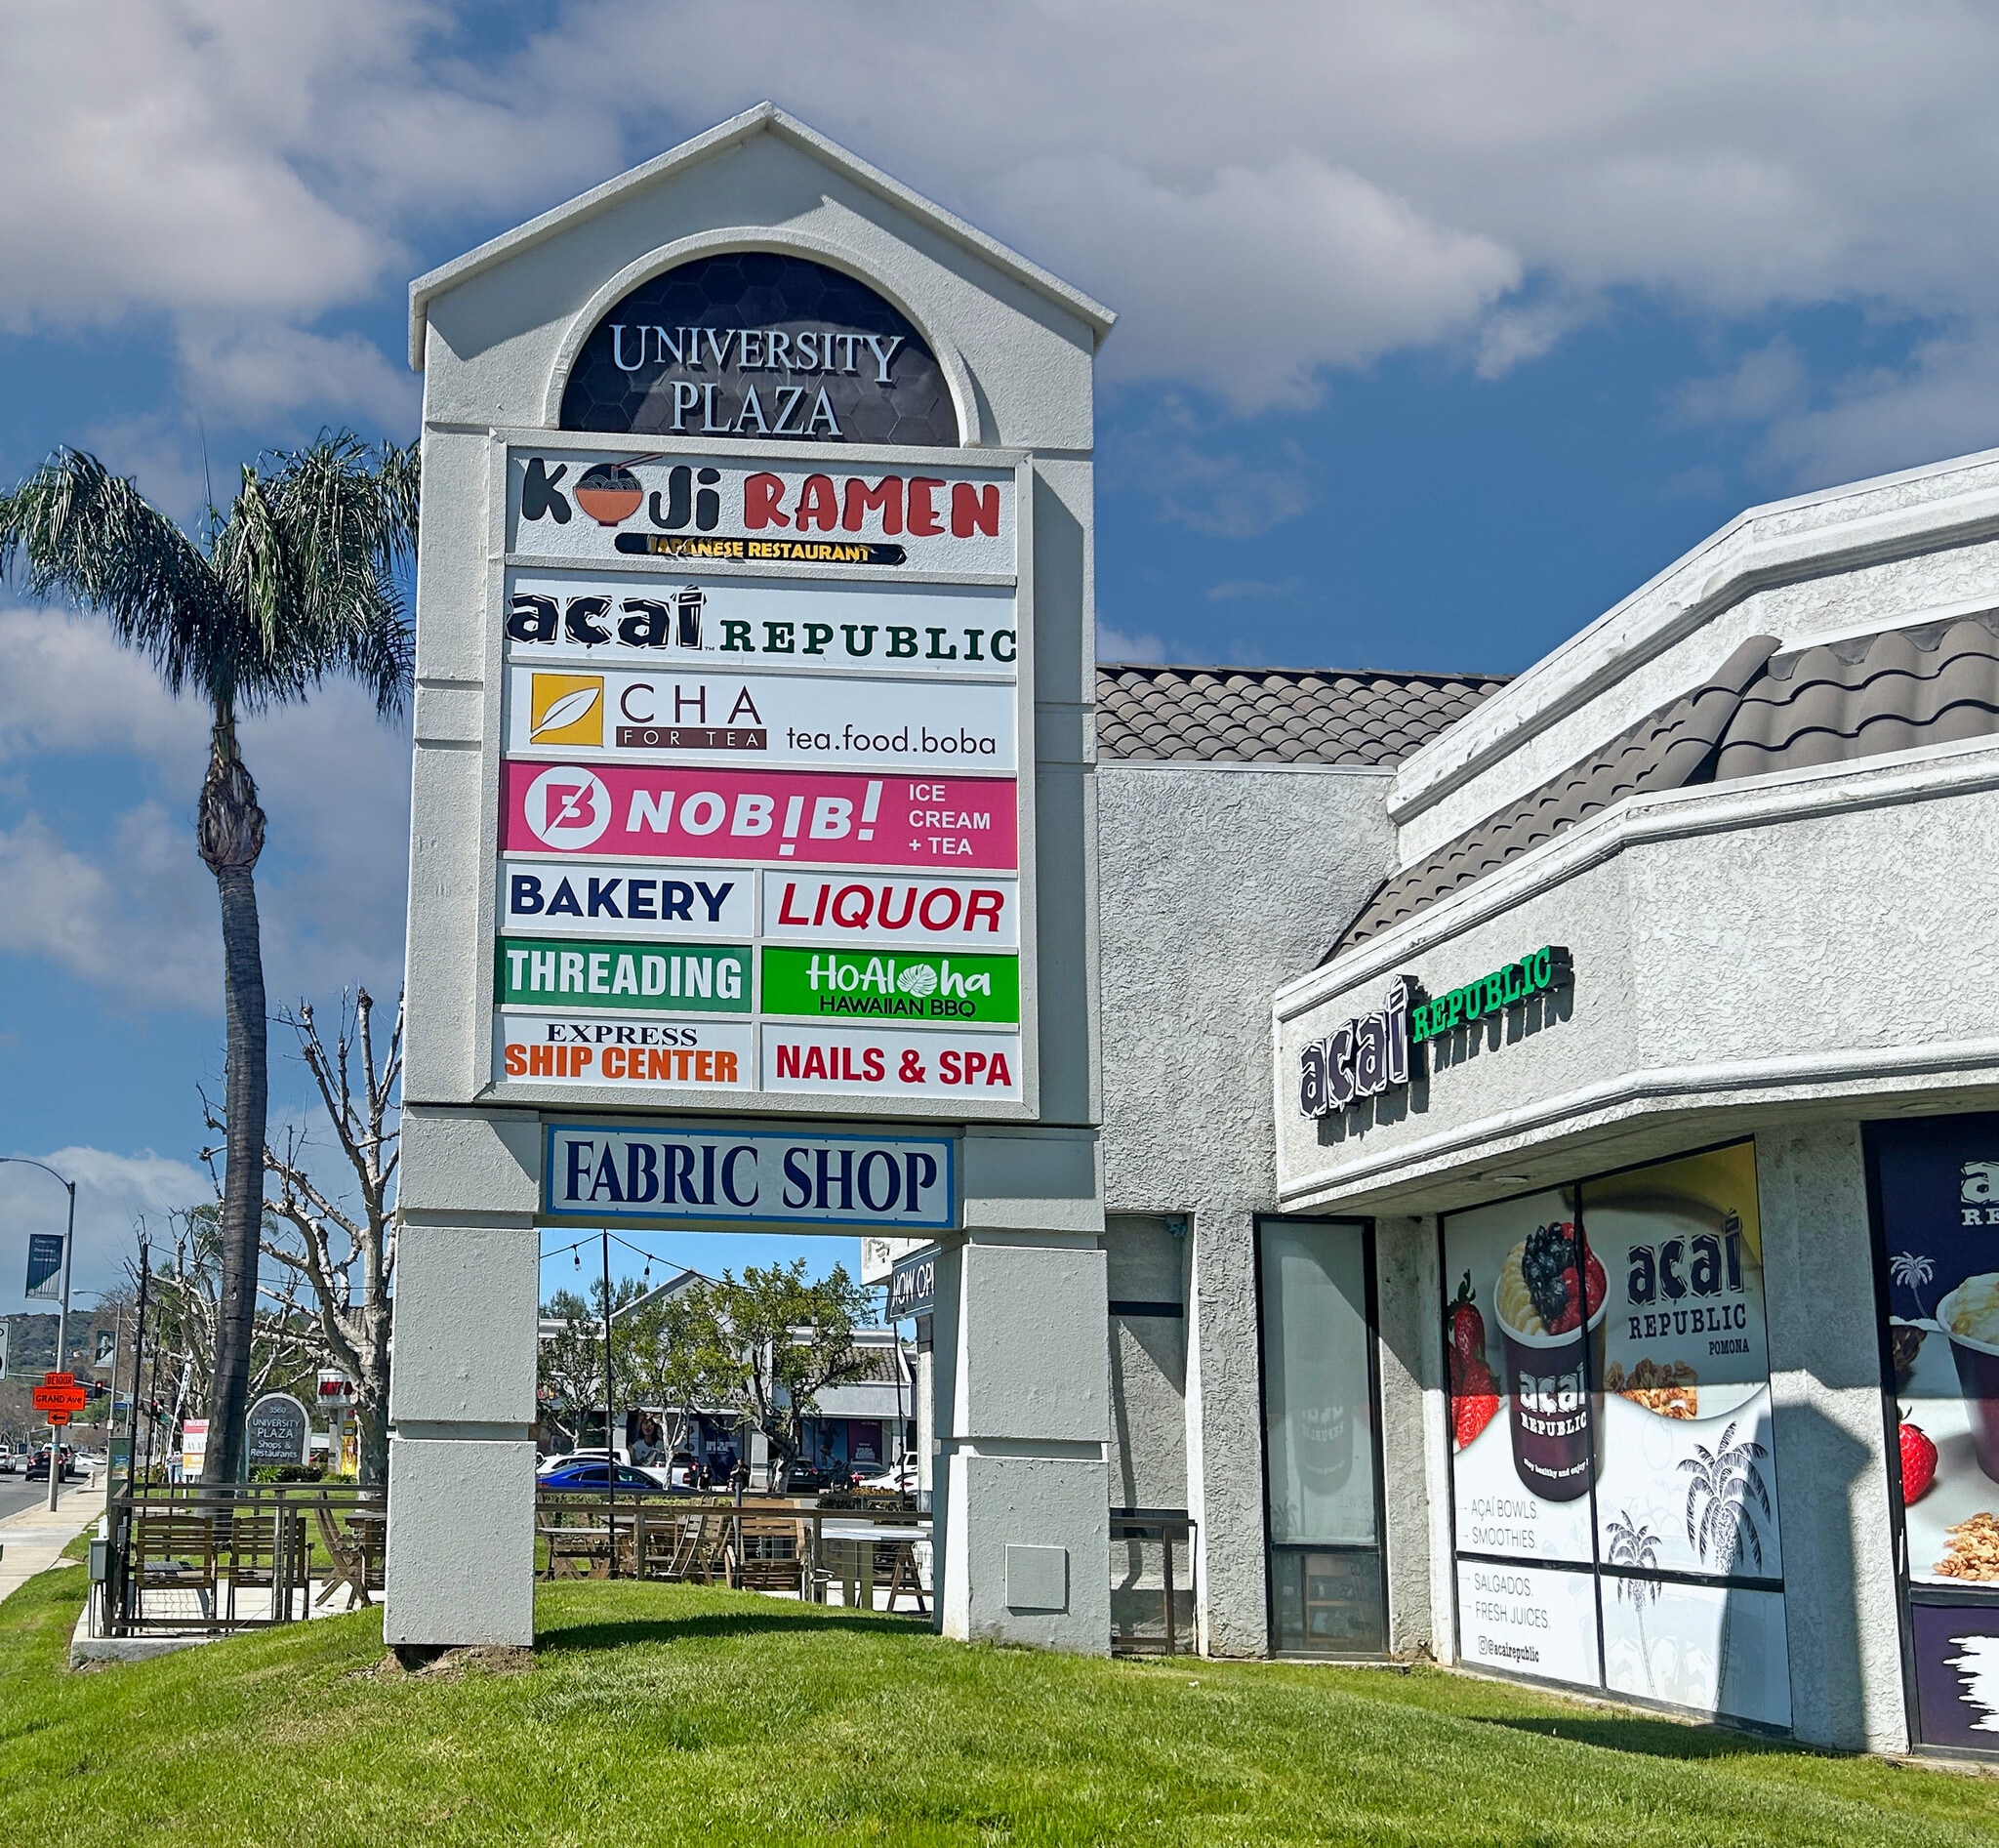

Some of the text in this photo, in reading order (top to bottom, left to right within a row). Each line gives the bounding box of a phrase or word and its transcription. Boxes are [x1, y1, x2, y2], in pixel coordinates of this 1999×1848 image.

[609, 324, 904, 384] UNIVERSITY
[670, 381, 843, 436] PLAZA
[743, 472, 1000, 538] RAMEN
[649, 537, 870, 561] JAPANESE RESTAURANT
[719, 619, 1016, 663] REPUBLIC
[620, 683, 762, 724] CHA
[623, 728, 760, 748] FOR TEA
[787, 723, 997, 755] tea.food.boba
[909, 784, 946, 802] ICE
[909, 810, 991, 830] CREAM
[927, 837, 973, 855] TEA
[510, 875, 735, 922] BAKERY
[778, 883, 1004, 932] LIQUOR
[507, 949, 742, 999] THREADING
[819, 994, 976, 1018] HAWAIIAN BBQ
[1411, 944, 1552, 1044] REPUBLIC
[546, 1023, 699, 1047] EXPRESS
[505, 1044, 738, 1083] SHIP CENTER
[777, 1044, 1012, 1087] NAILS & SPA
[564, 1140, 938, 1212] FABRIC SHOP
[892, 1260, 934, 1306] NOW OP
[1628, 1302, 1746, 1340] REPUBLIC
[1709, 1337, 1750, 1356] POMONA
[47, 1376, 72, 1385] DETOUR
[35, 1394, 83, 1404] GRAND Ave
[268, 1406, 287, 1415] 3560
[253, 1418, 301, 1427] UNIVERSITY
[257, 1427, 294, 1439] PLAZA
[1520, 1411, 1587, 1437] REPUBLIC
[250, 1448, 298, 1458] Restaurants
[258, 1440, 292, 1450] Shops &
[1475, 1601, 1508, 1622] FRESH
